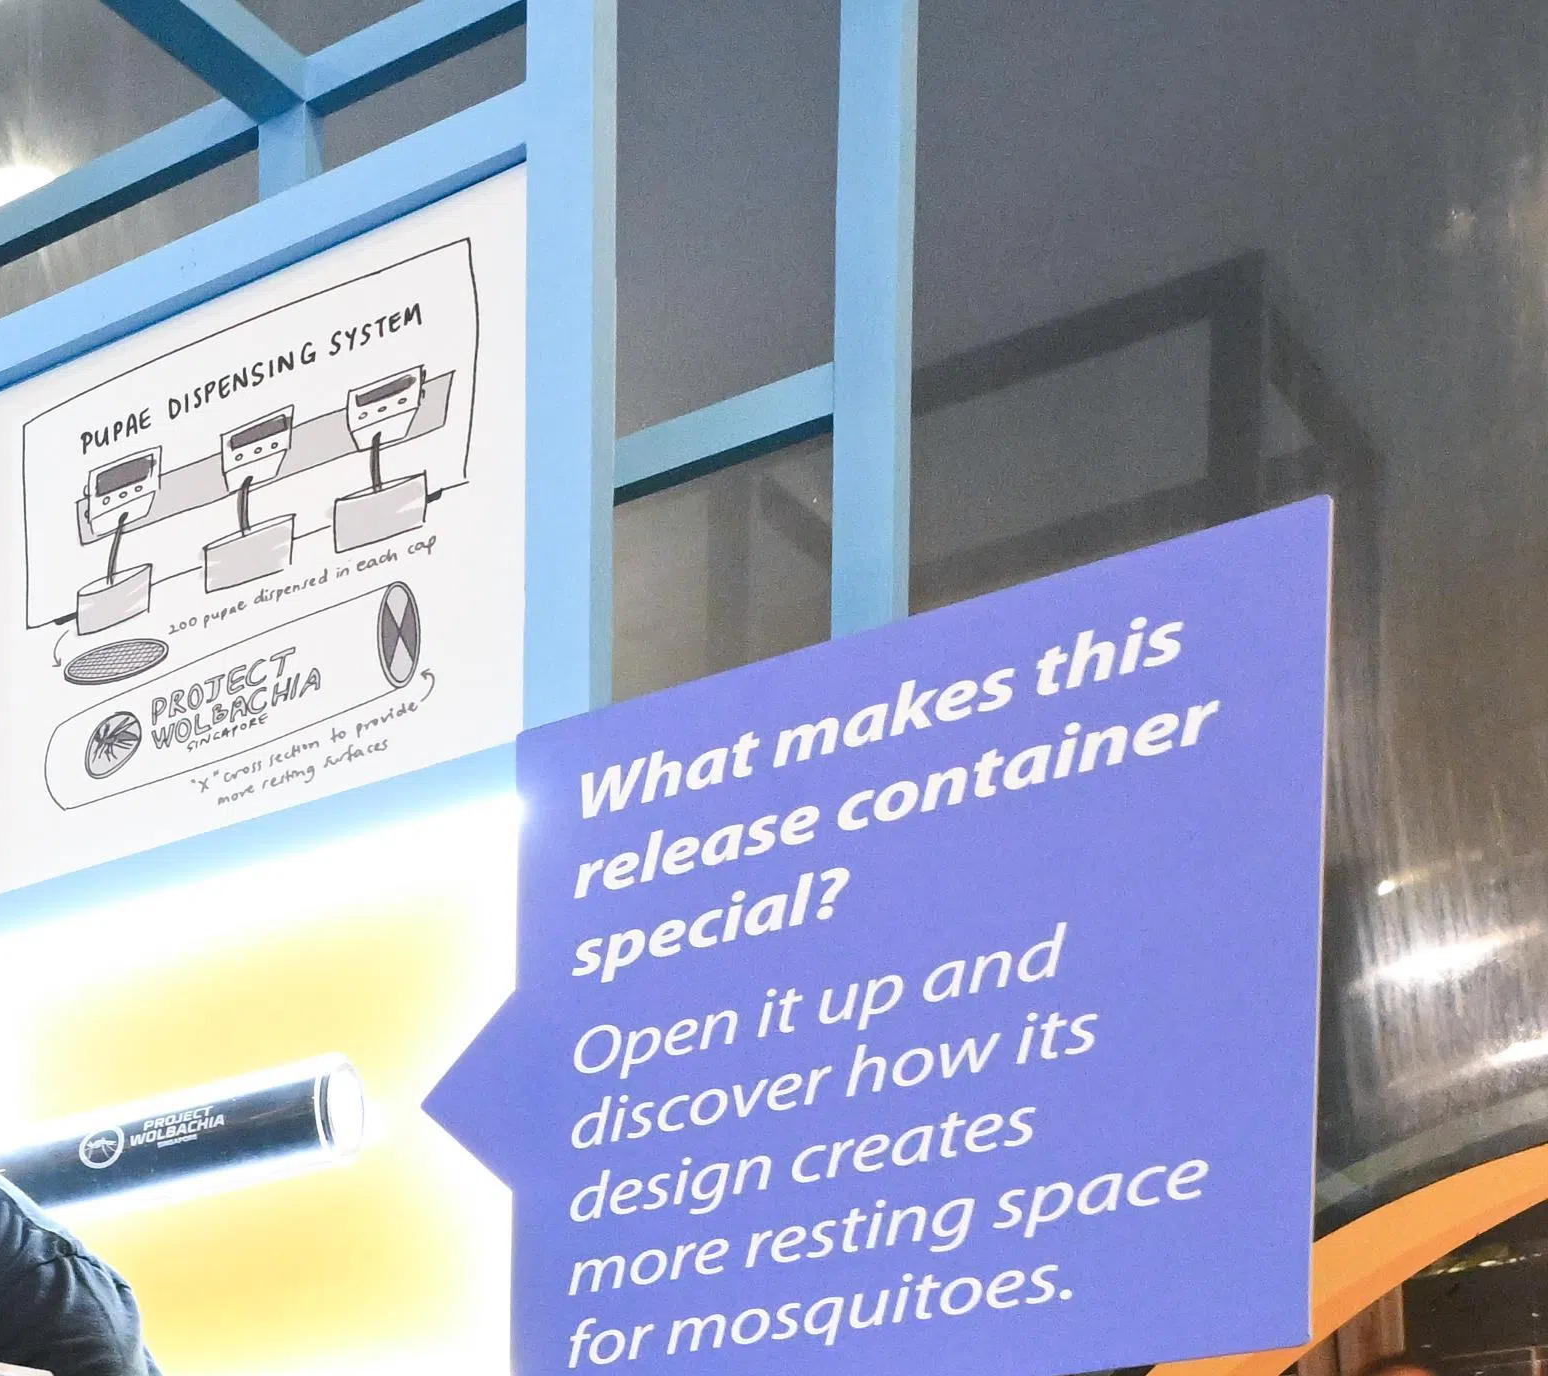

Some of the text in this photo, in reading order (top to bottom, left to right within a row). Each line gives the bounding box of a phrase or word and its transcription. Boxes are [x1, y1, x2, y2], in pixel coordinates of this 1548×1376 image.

[81, 303, 422, 453] PUPAE DISPENSING SYSTEM
[167, 534, 437, 635] 200 pupae dispensed in each cap
[151, 648, 295, 725] PROJECT
[151, 667, 321, 749] WOLBACHIA
[577, 618, 1183, 818] What makes this
[217, 737, 388, 805] more resting surfaces
[573, 700, 1218, 898] release container
[572, 867, 850, 982] special?
[573, 923, 1066, 1086] Open it up and
[130, 1114, 225, 1146] WOLBACHIA
[143, 1106, 213, 1130] PROJECT
[571, 1009, 1097, 1149] discover how its
[570, 1102, 1036, 1229] design creates
[568, 1157, 1209, 1295] more resting space
[568, 1262, 1072, 1370] for mosquitoes.
